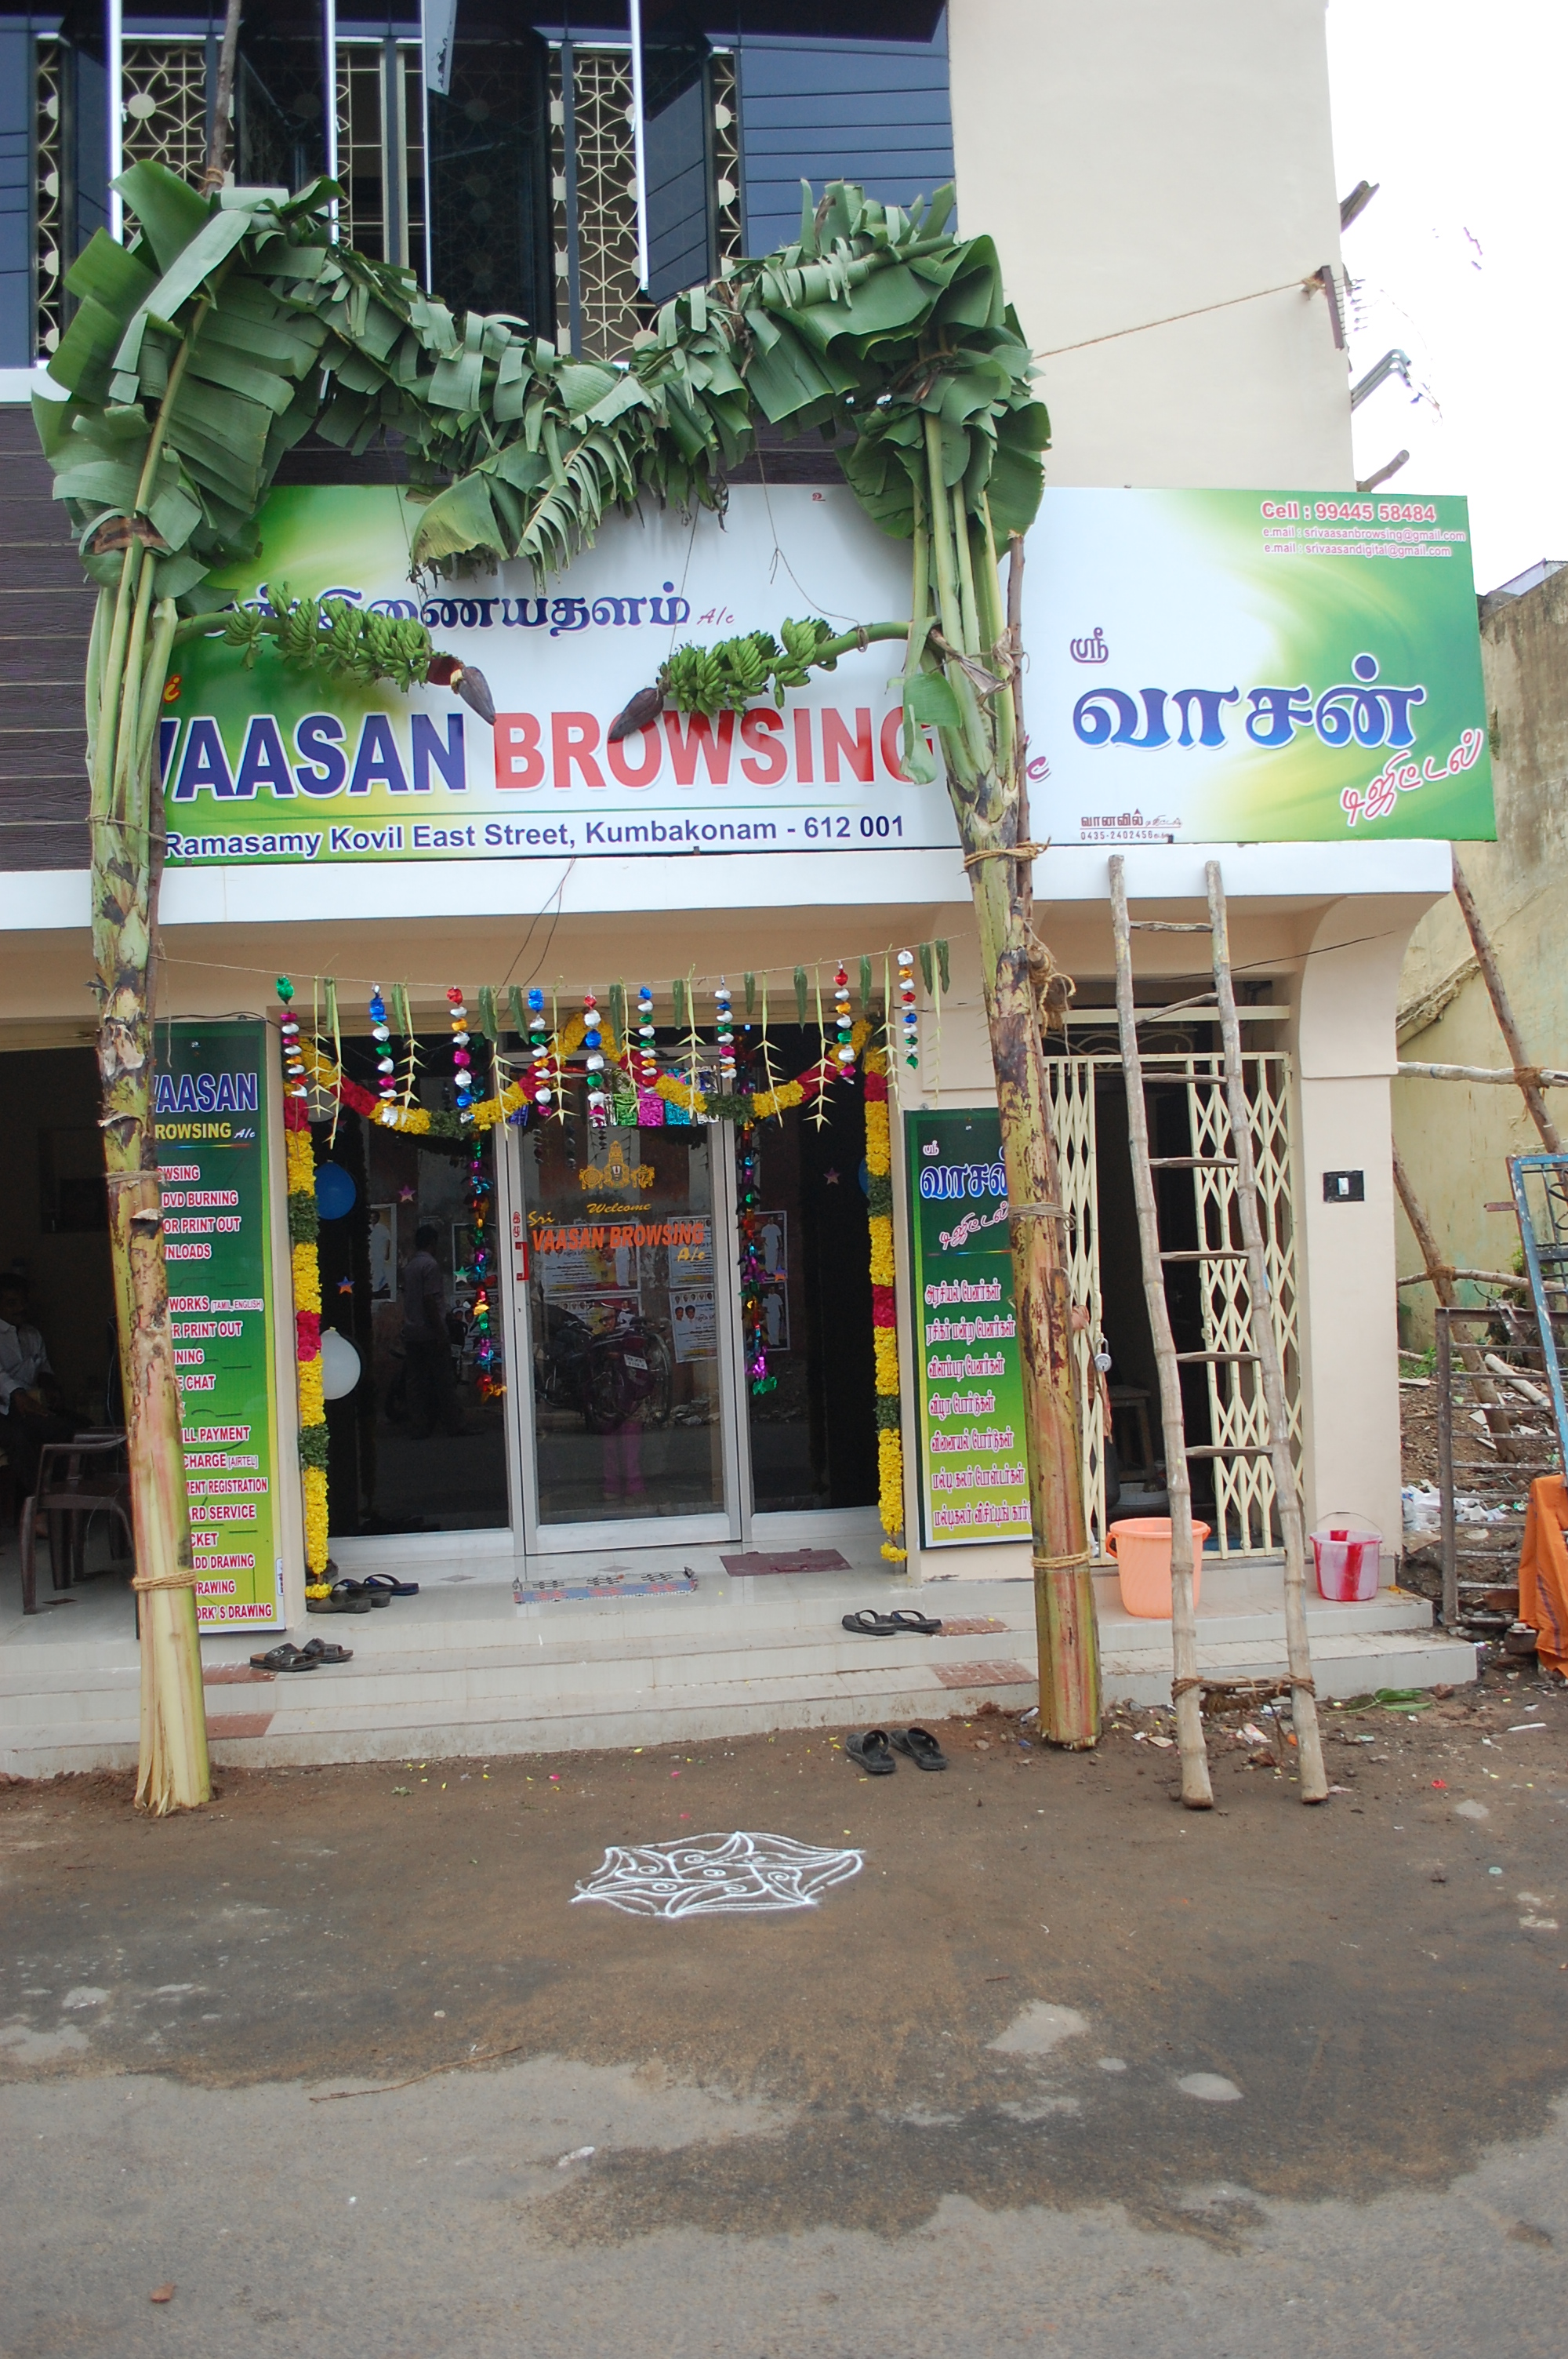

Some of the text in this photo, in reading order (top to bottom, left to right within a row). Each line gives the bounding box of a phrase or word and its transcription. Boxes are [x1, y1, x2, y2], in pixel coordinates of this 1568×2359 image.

[1261, 502, 1298, 518] Cell
[1316, 503, 1373, 520] 99445
[1379, 505, 1436, 522] 58484
[1263, 527, 1294, 537] e.mail
[1305, 528, 1465, 543] srivaasanbrowsing@gmail.com
[1265, 543, 1295, 554] e.mail
[1305, 543, 1451, 558] srivaasandigital@gmail.com
[1073, 654, 1425, 748] வாசன்
[1341, 730, 1482, 825] டிஜிட்டல்
[165, 834, 321, 858] Ramasamy
[330, 826, 403, 850] Kovil
[413, 825, 476, 849] East
[485, 823, 575, 849] Street,
[586, 820, 777, 844] Kumbakonam
[804, 816, 851, 838] 612
[859, 815, 903, 838] 001
[154, 1072, 258, 1112] AASAN
[162, 1190, 238, 1208] DVD BURNING
[586, 1201, 652, 1214] Welcome
[181, 1216, 216, 1234] PRINT
[217, 1216, 241, 1232] OUT
[528, 1210, 555, 1227] Sri
[532, 1222, 705, 1252] VAASAN BROWSING
[165, 1243, 212, 1260] NLOADS
[169, 1296, 209, 1313] WORKS
[183, 1321, 216, 1338] PRINT
[219, 1321, 243, 1337] OUT
[185, 1374, 216, 1390] CHAT
[198, 1425, 251, 1441] PAYMENT
[207, 1477, 268, 1493] REGISTRATION
[209, 1504, 256, 1521] SERVICE
[1011, 1499, 1033, 1524] கார்
[210, 1554, 255, 1568] DRAWING
[195, 1579, 236, 1595] RAWING
[227, 1604, 273, 1619] DRAWING
